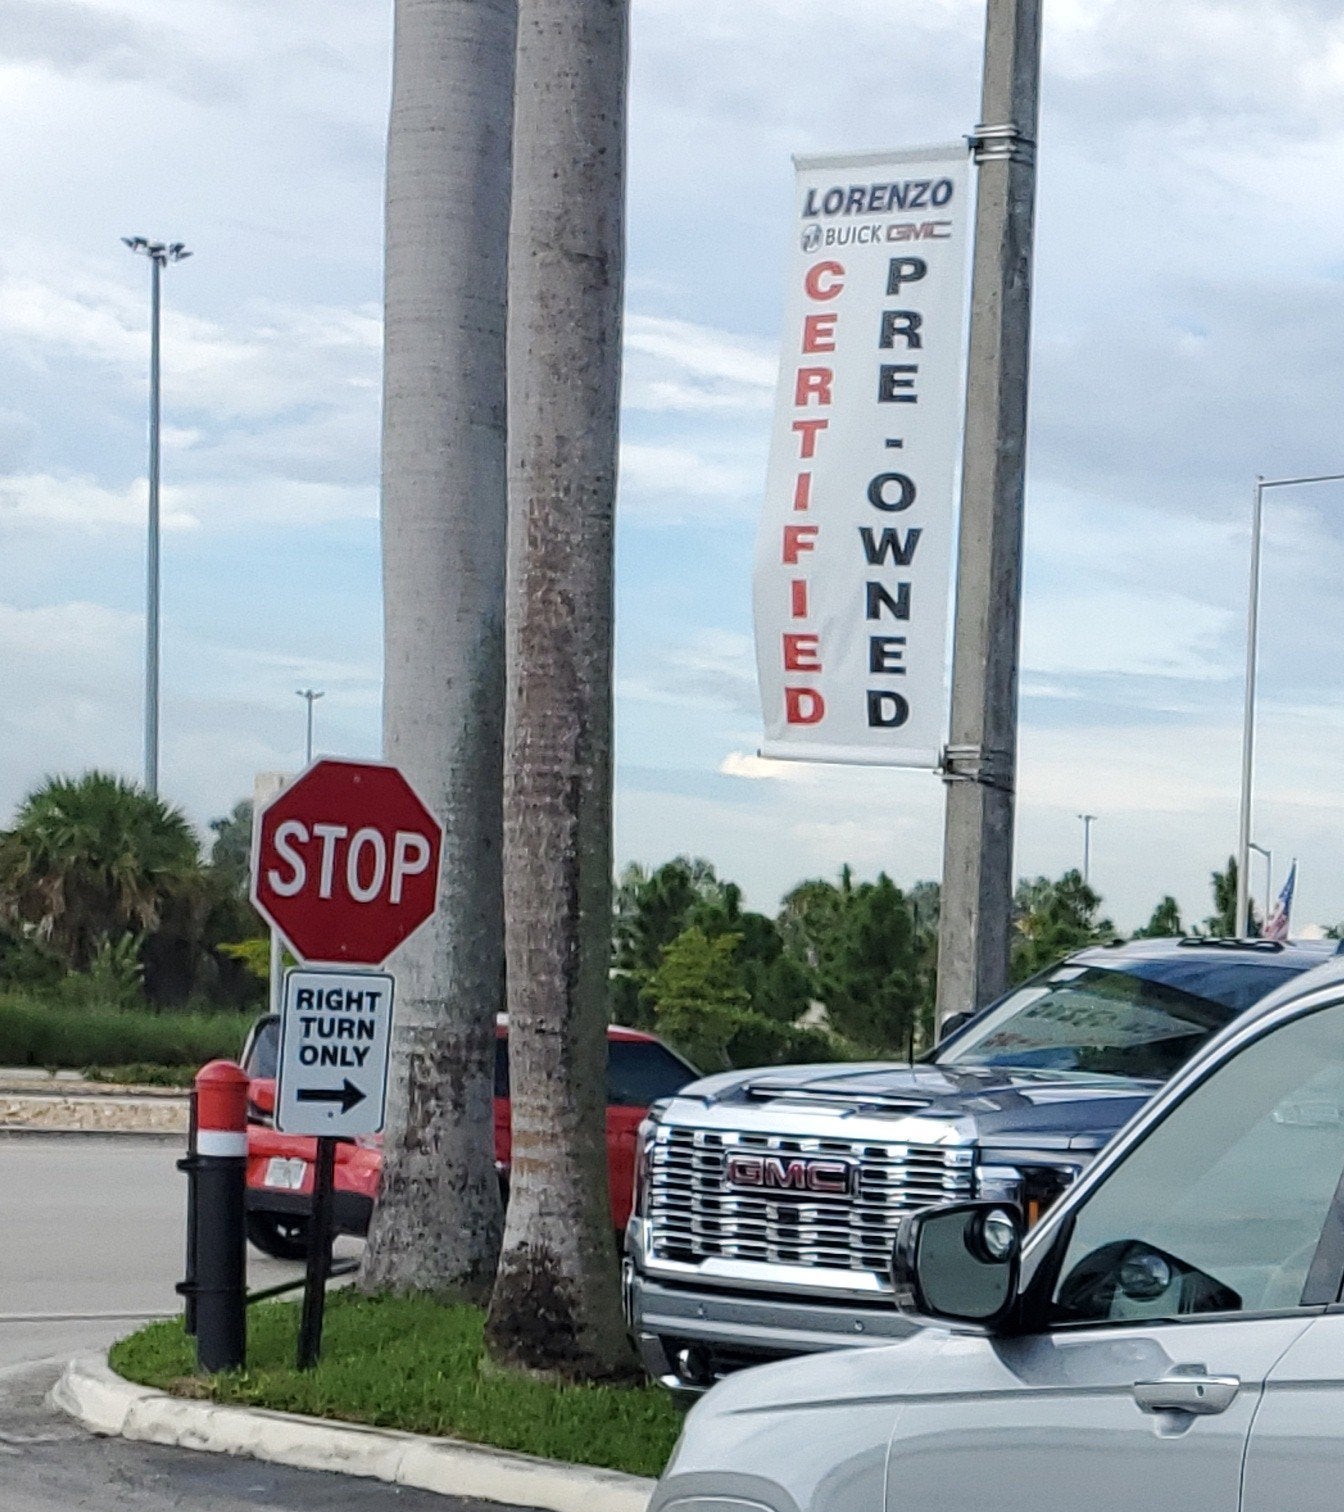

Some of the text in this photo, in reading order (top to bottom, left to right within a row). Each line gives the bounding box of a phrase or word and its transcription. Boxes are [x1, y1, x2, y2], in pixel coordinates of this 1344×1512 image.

[802, 178, 954, 219] LORENZO
[825, 220, 953, 246] BUICK GMC
[781, 260, 846, 727] CERTIFIED
[858, 257, 928, 729] PRE-OWNED
[267, 819, 431, 904] STOP
[296, 988, 383, 1013] RIGHT
[299, 1017, 375, 1041] TURN
[300, 1044, 371, 1068] ONLY
[726, 1156, 848, 1192] GMC
